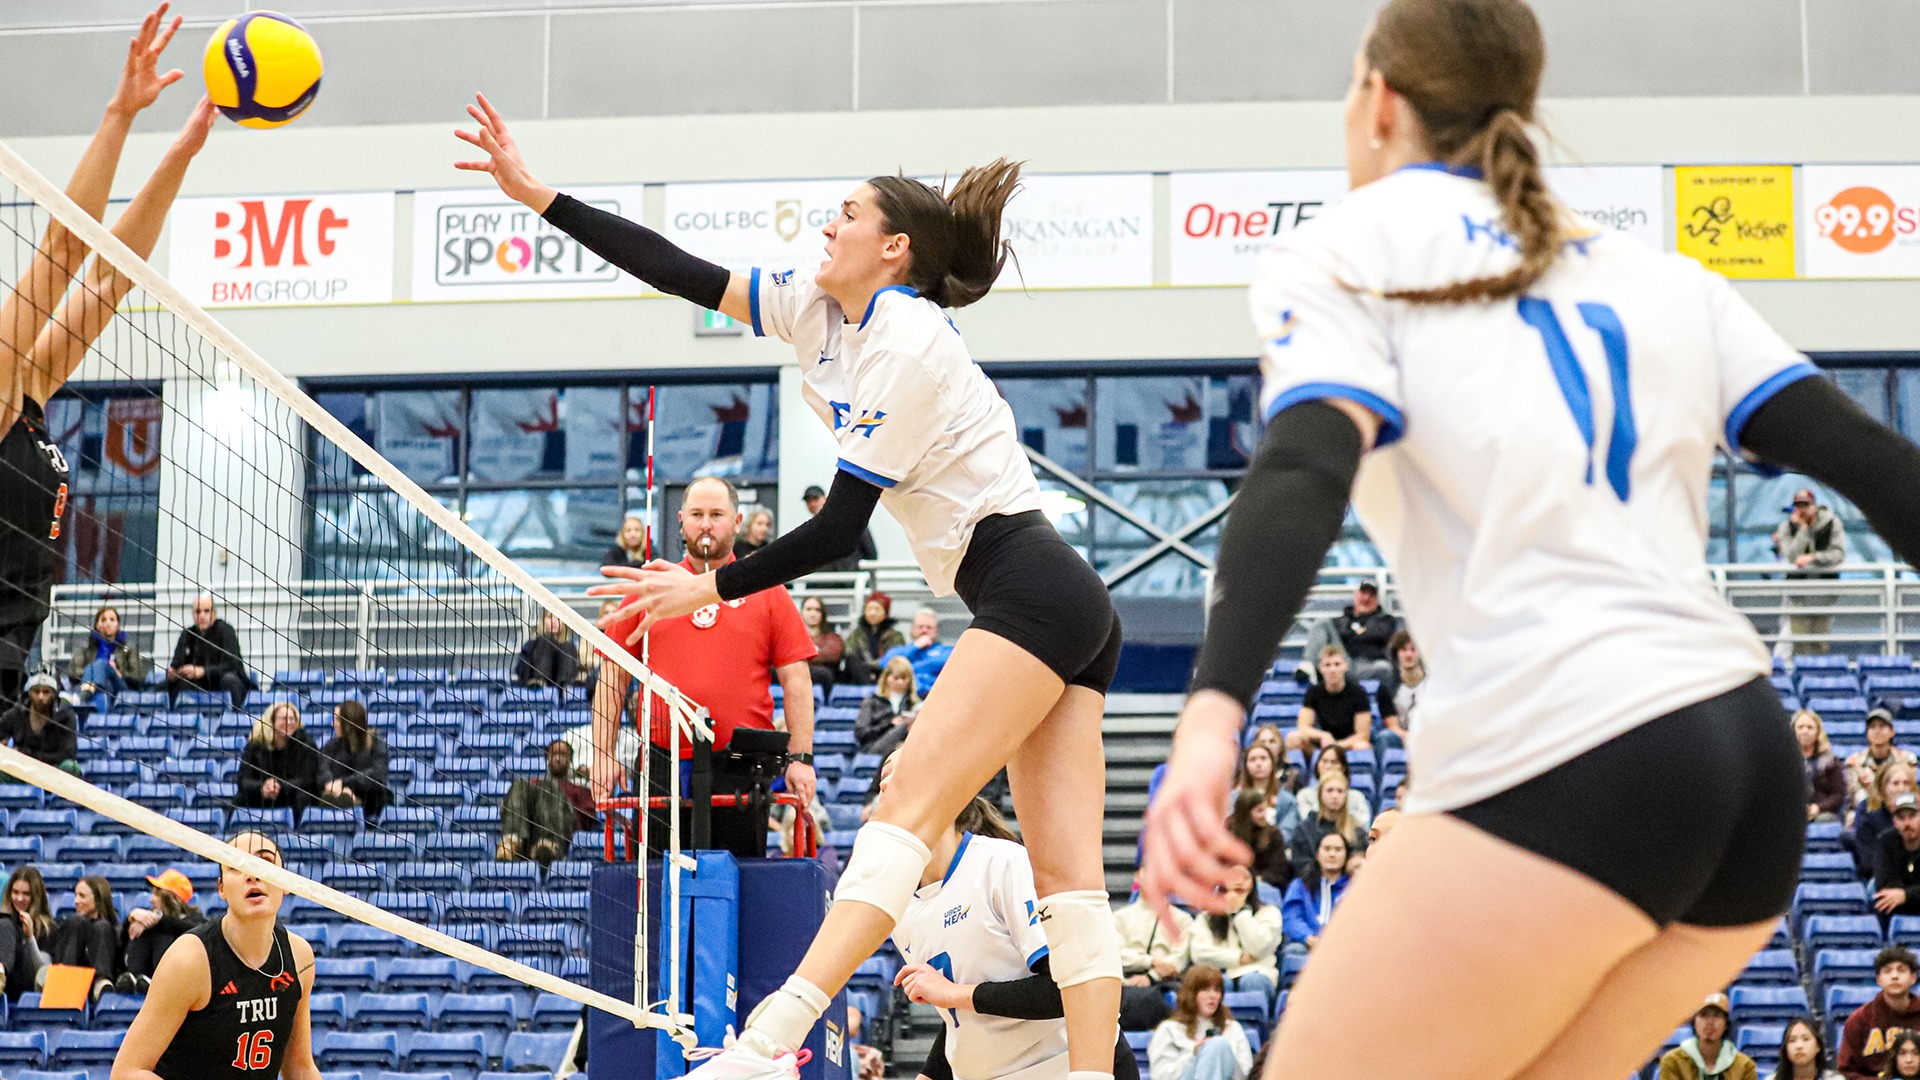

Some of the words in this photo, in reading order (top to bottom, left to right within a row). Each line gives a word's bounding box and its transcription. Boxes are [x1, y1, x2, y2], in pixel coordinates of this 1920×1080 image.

[213, 199, 349, 267] BMG
[445, 213, 501, 235] PLAY
[510, 212, 531, 232] IT
[674, 210, 768, 231] GOLFBC
[1814, 203, 1890, 238] 99.9
[212, 278, 348, 302] BMGROUP
[236, 997, 278, 1023] TRU
[231, 1029, 274, 1070] 16
